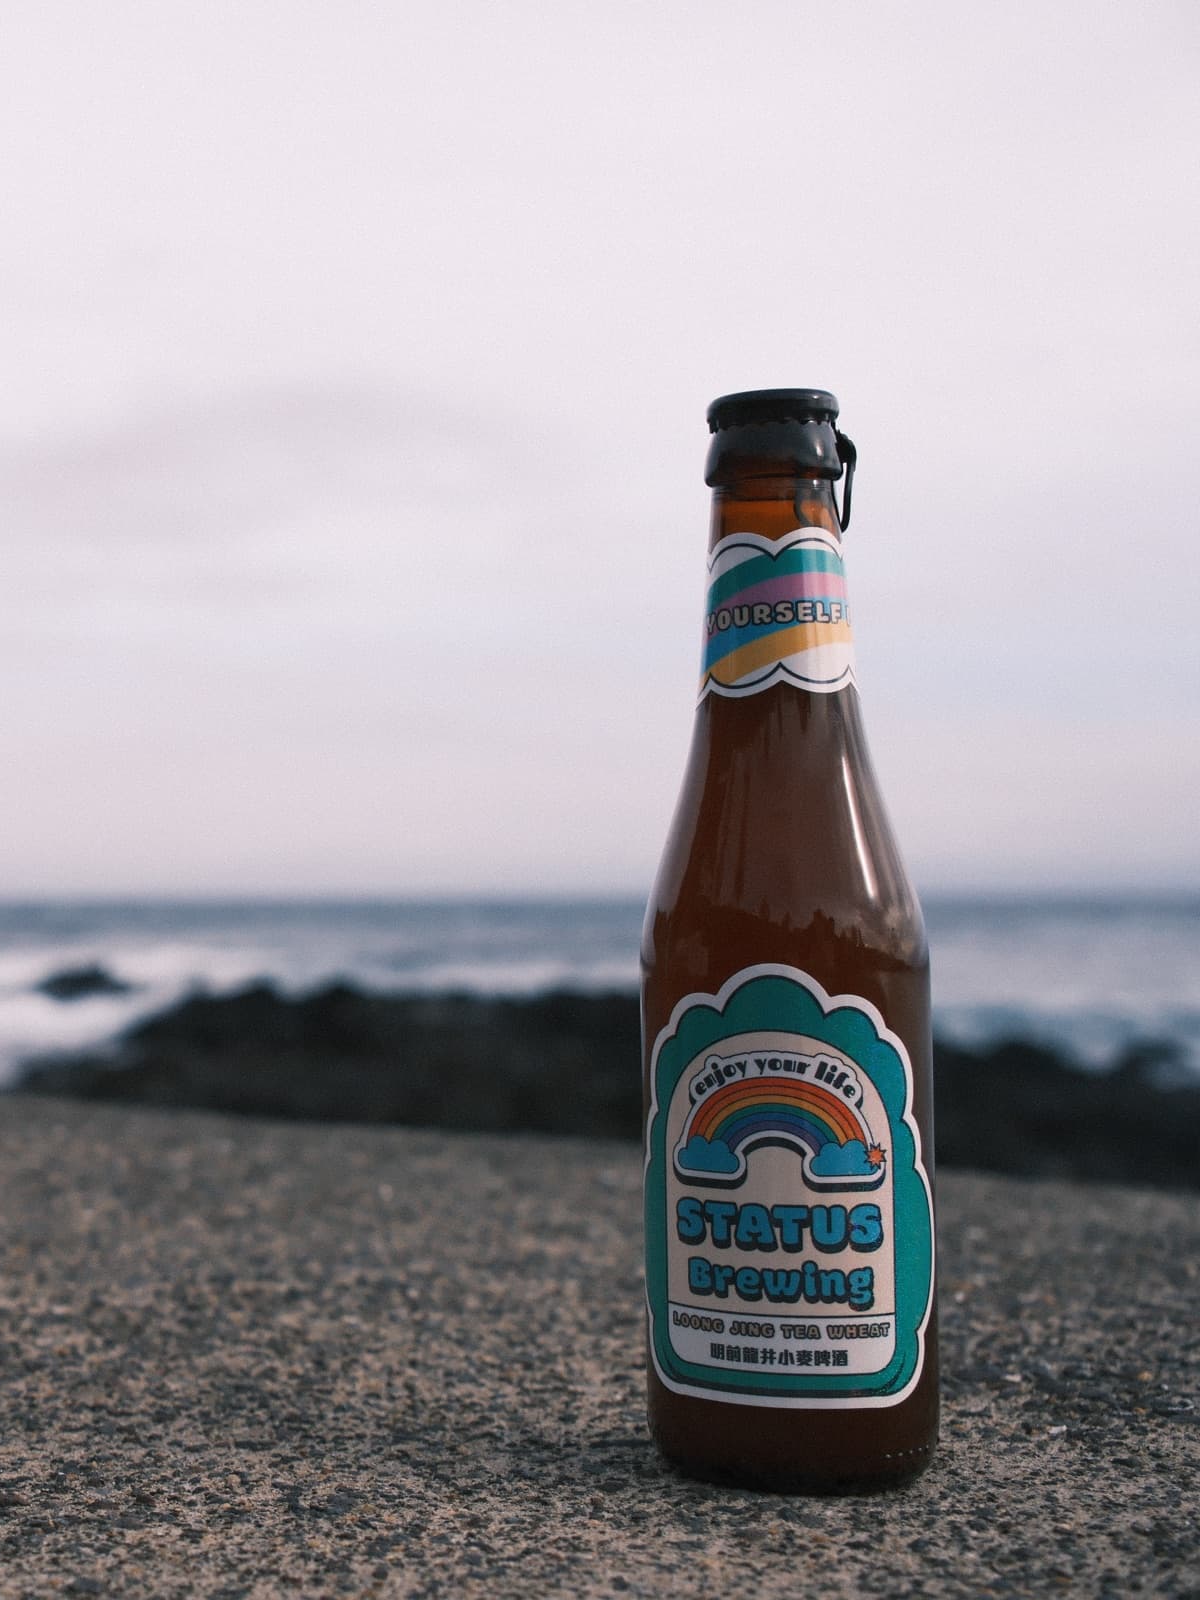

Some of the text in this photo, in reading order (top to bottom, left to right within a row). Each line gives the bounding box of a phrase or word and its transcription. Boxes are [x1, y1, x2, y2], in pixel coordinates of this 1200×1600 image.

[705, 600, 843, 632] YOURSELF
[695, 1056, 857, 1099] enjoy your life
[676, 1196, 884, 1253] STATUS
[688, 1257, 875, 1311] Brewing
[673, 1311, 891, 1340] LOONG JING TEA WHEAT
[710, 1343, 849, 1367] 明前龍井小麥啤酒
